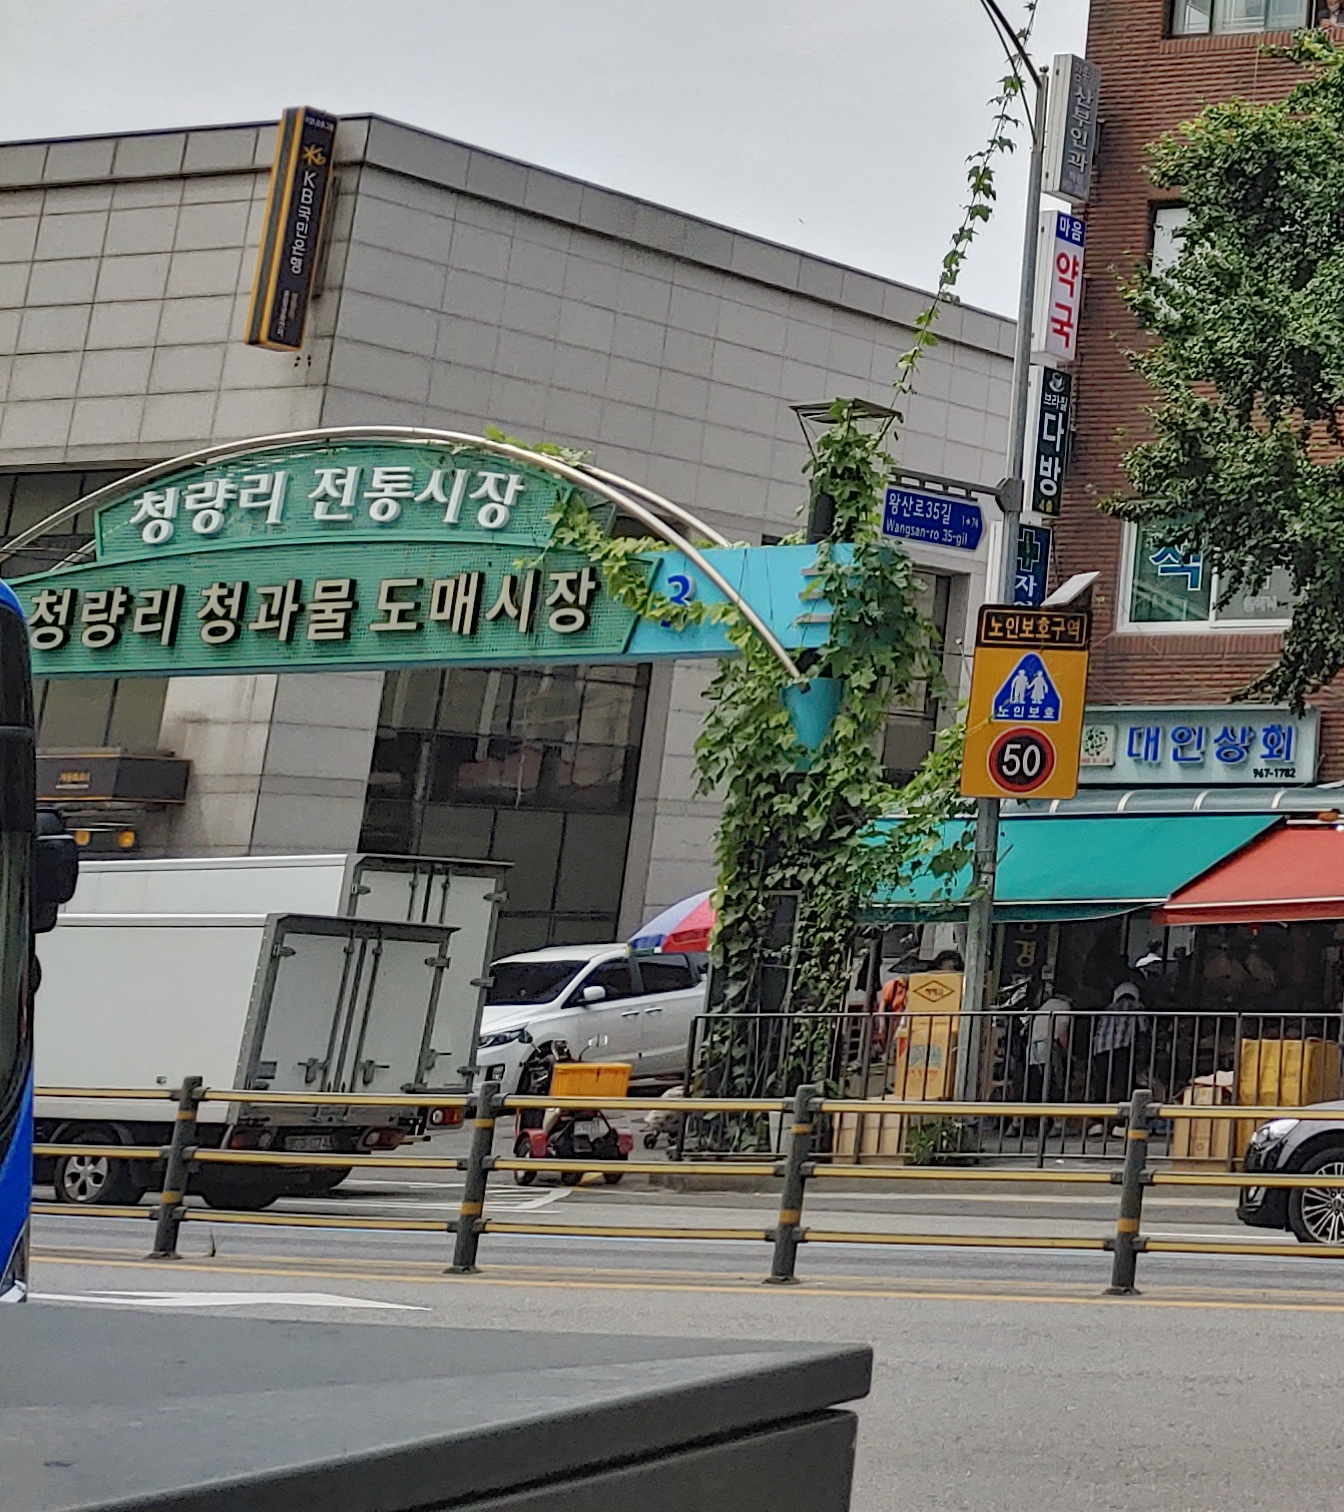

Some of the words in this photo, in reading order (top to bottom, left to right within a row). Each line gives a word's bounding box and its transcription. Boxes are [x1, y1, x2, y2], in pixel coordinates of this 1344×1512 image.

[1058, 216, 1083, 242] 마음
[1050, 251, 1080, 349] 약국
[1043, 391, 1069, 413] 브라질
[1038, 412, 1065, 497] 다방
[130, 468, 291, 546] 청량리
[307, 464, 526, 530] 전통시장
[888, 492, 952, 526] 왕산로35길
[885, 517, 940, 541] Wangsan-ro
[941, 528, 969, 546] 35-gil
[28, 582, 185, 650] 청량리
[196, 576, 357, 646] 청과물
[366, 564, 601, 636] 도매시장
[988, 615, 1081, 642] 노인보호구역
[996, 705, 1055, 719] 노인보호
[1001, 743, 1042, 777] 50
[1126, 723, 1297, 764] 대인상회
[1252, 767, 1297, 779] 967-1782
